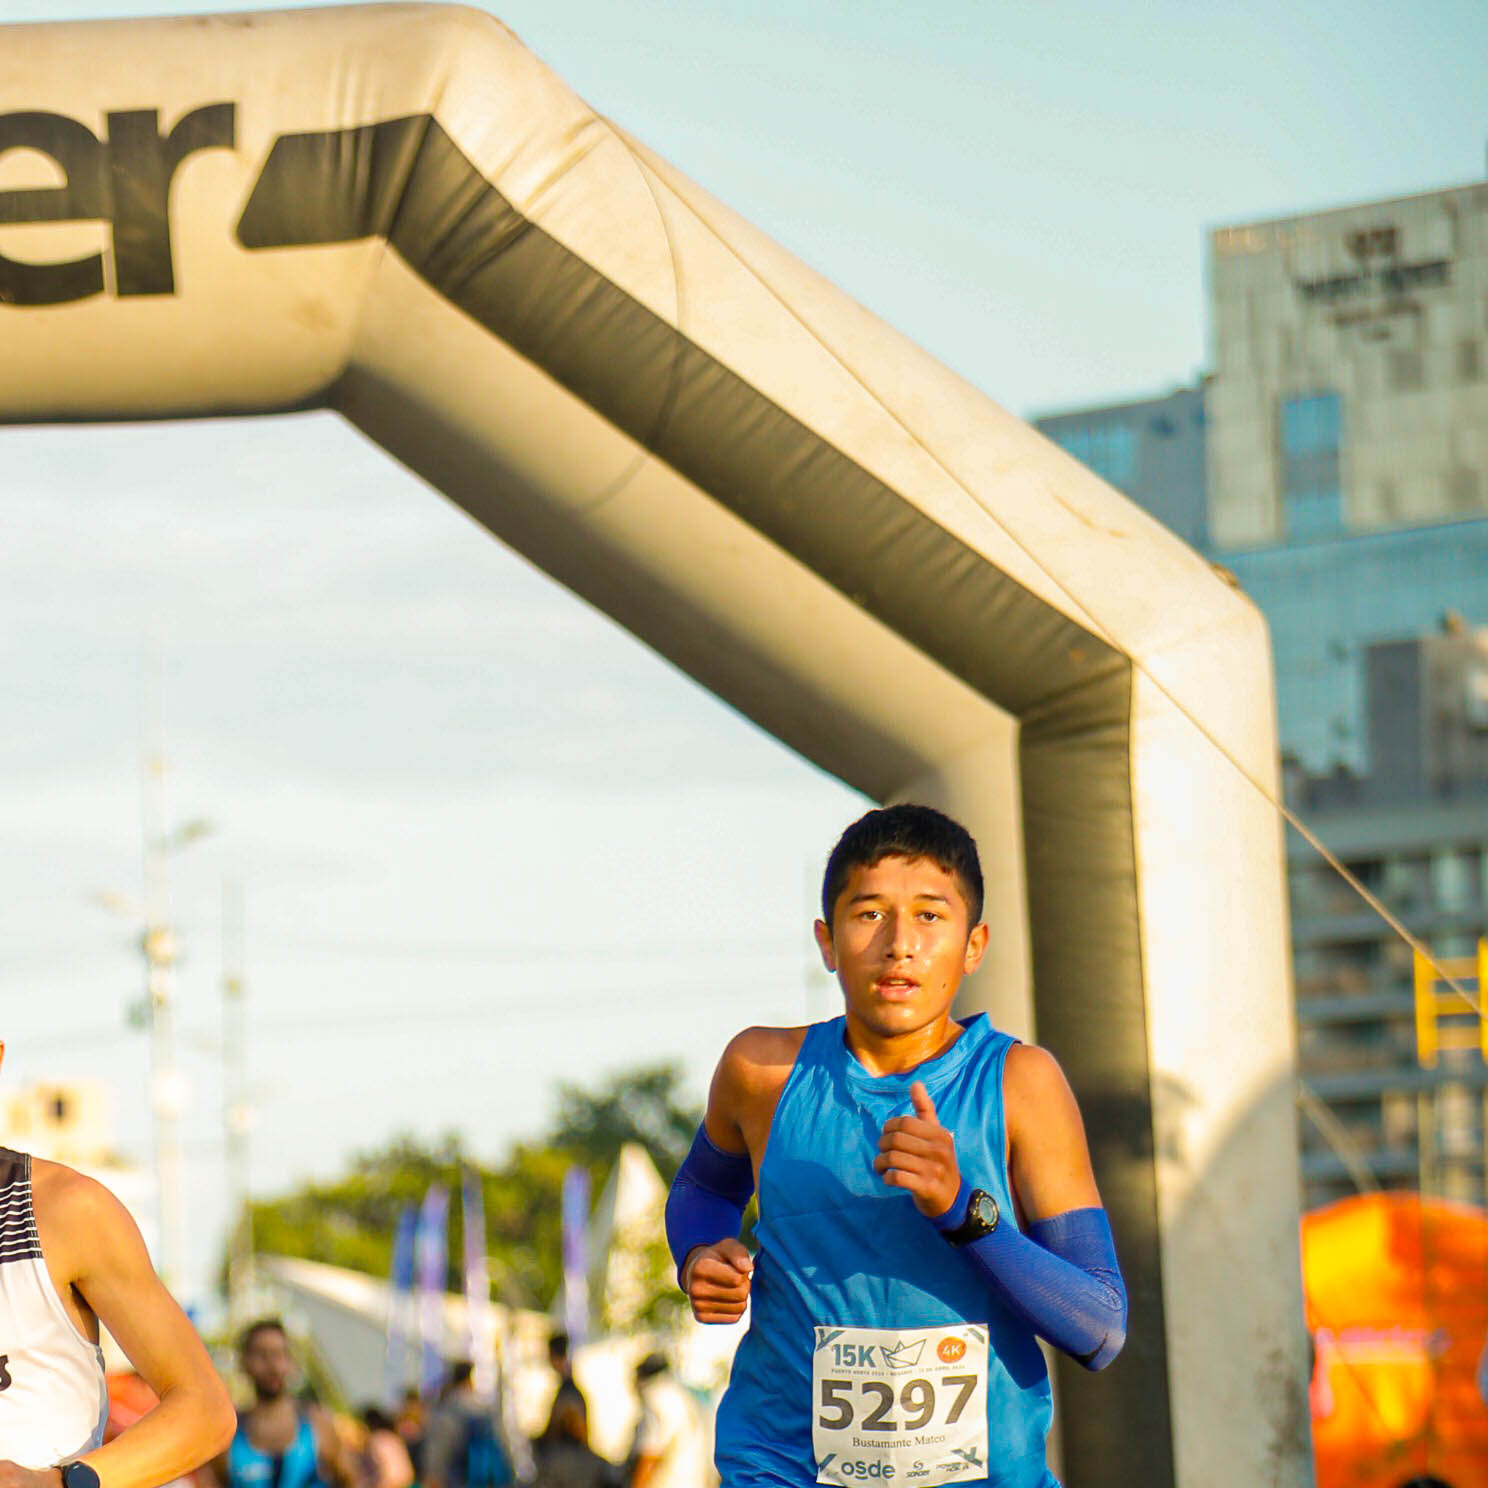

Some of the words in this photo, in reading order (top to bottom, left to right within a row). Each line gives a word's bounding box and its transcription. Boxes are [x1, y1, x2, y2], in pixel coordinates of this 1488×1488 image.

[831, 1343, 876, 1368] 15K
[942, 1342, 962, 1356] 4K
[819, 1373, 979, 1431] 5297
[852, 1436, 912, 1449] Bustamante
[840, 1459, 896, 1480] osde
